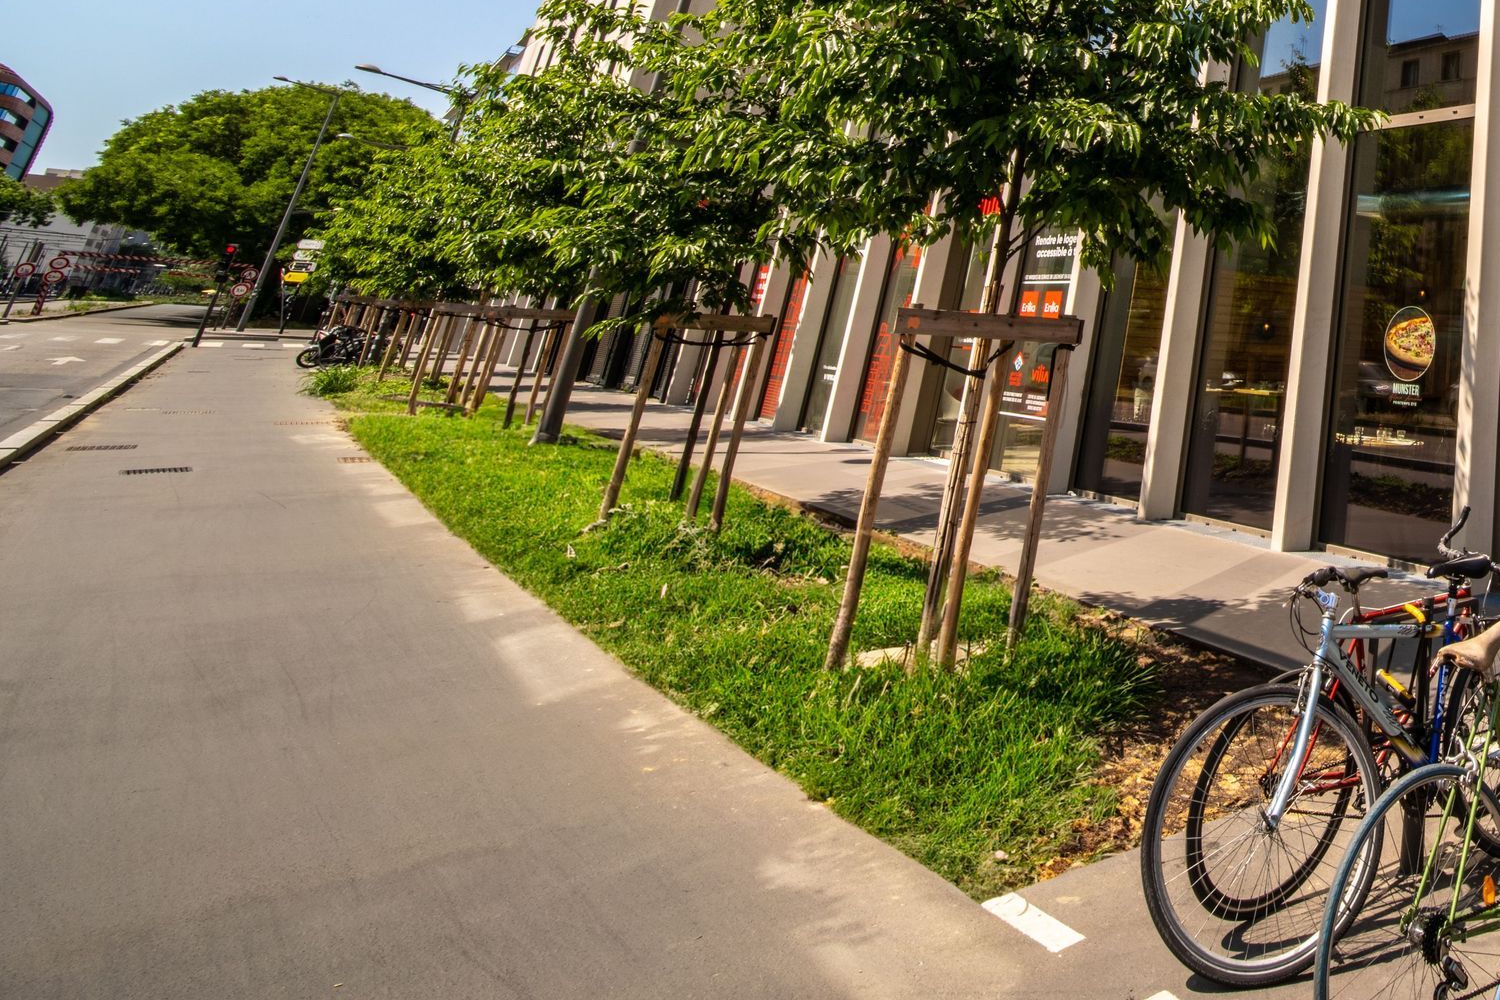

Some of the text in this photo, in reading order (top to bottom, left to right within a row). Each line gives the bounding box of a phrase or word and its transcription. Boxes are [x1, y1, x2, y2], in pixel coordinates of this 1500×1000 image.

[1035, 233, 1078, 246] Rendre le loge
[1036, 246, 1068, 258] accessible
[1392, 382, 1420, 396] MUNSTER
[1338, 646, 1379, 703] VENETO
